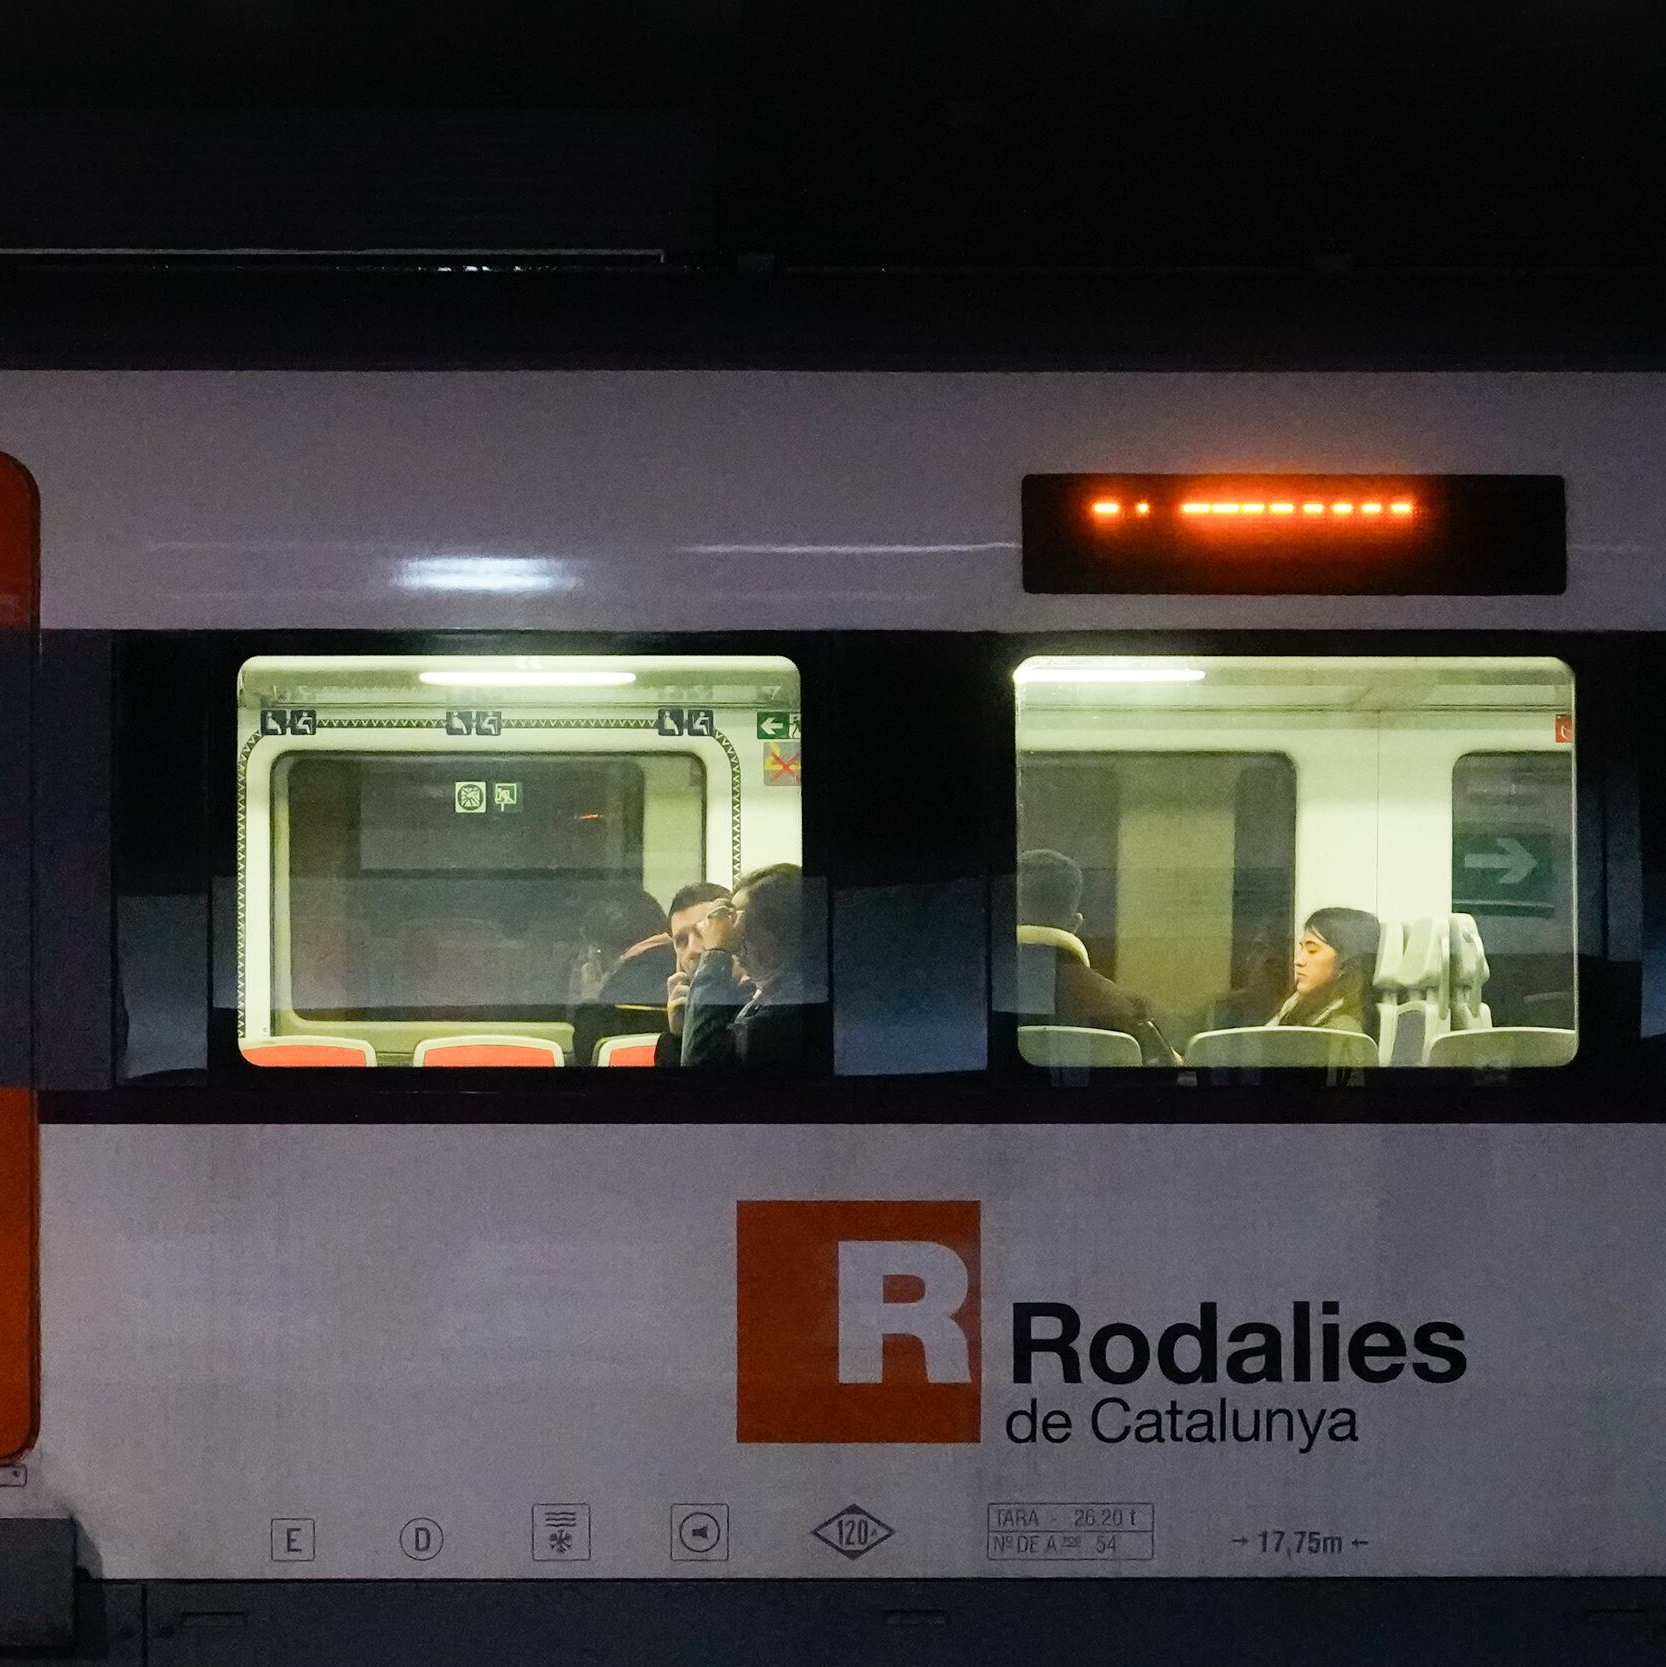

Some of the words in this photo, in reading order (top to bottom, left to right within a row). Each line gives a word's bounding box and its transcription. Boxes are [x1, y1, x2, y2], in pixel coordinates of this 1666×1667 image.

[838, 1240, 972, 1385] R
[1012, 1300, 1468, 1386] Rodalies
[1004, 1397, 1073, 1444] de
[1090, 1396, 1359, 1454] Catalunya
[995, 1508, 1039, 1527] TARA
[286, 1526, 301, 1553] E
[414, 1526, 431, 1552] D
[1017, 1535, 1039, 1554] DE
[1096, 1535, 1117, 1554] 54
